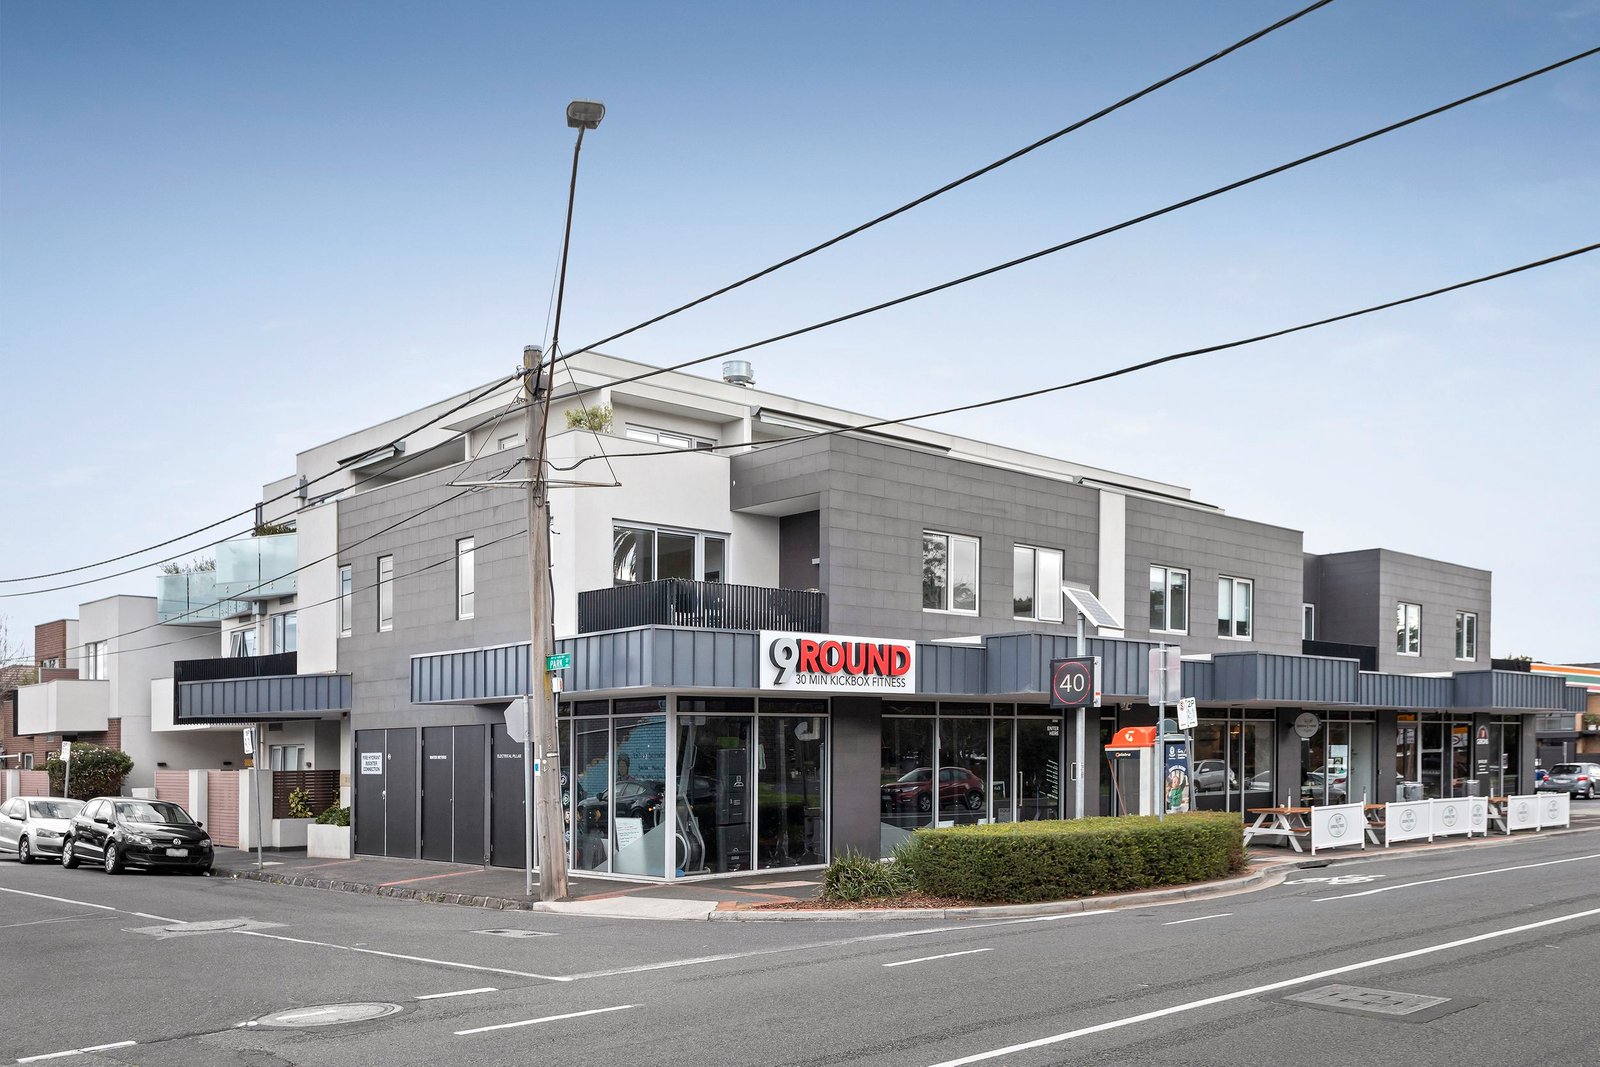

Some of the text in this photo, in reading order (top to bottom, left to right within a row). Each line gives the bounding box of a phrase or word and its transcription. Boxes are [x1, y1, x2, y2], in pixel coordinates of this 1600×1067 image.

[549, 659, 563, 669] PARK
[795, 673, 906, 688] 30 MIN KICKBOX FITNESS
[1059, 673, 1085, 693] 40
